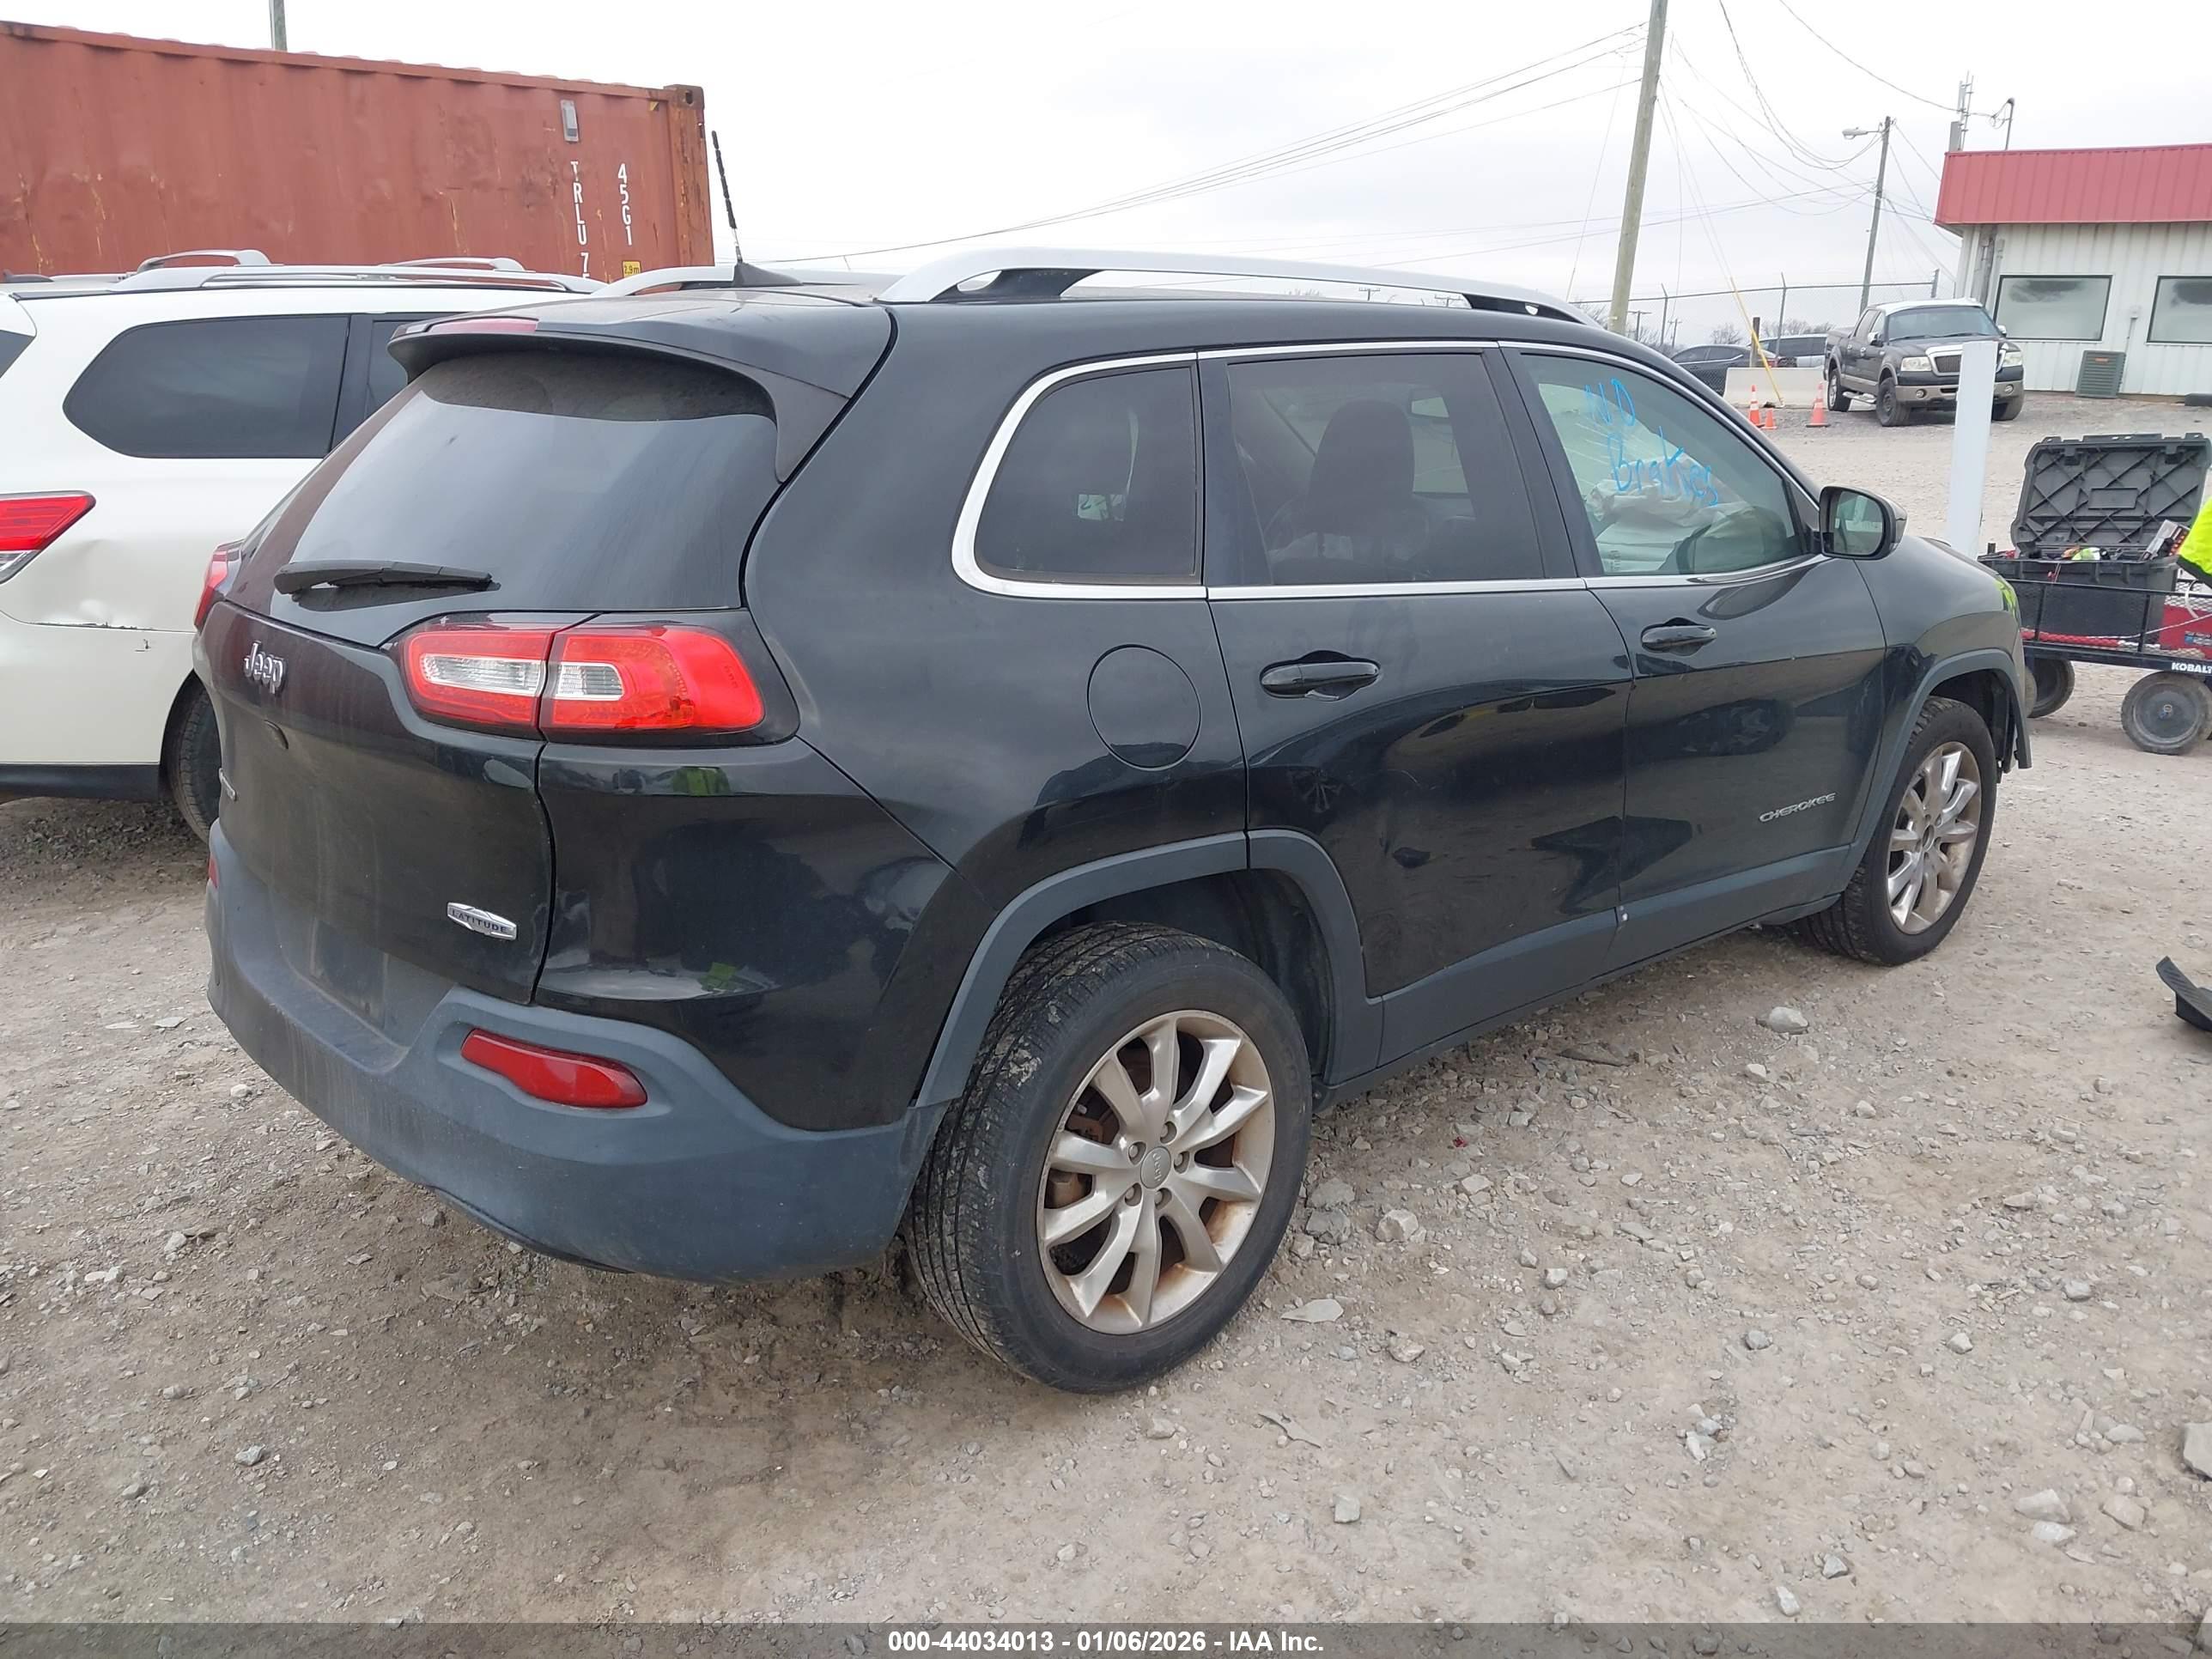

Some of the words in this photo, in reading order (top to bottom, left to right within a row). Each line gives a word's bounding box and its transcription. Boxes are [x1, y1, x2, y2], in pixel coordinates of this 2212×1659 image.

[570, 161, 587, 246] TRLU
[617, 162, 632, 246] 45G1
[243, 641, 285, 695] Jeep
[2171, 662, 2212, 674] KOBALT
[1759, 792, 1837, 823] CHEROKEE
[451, 908, 509, 933] LATITUDE
